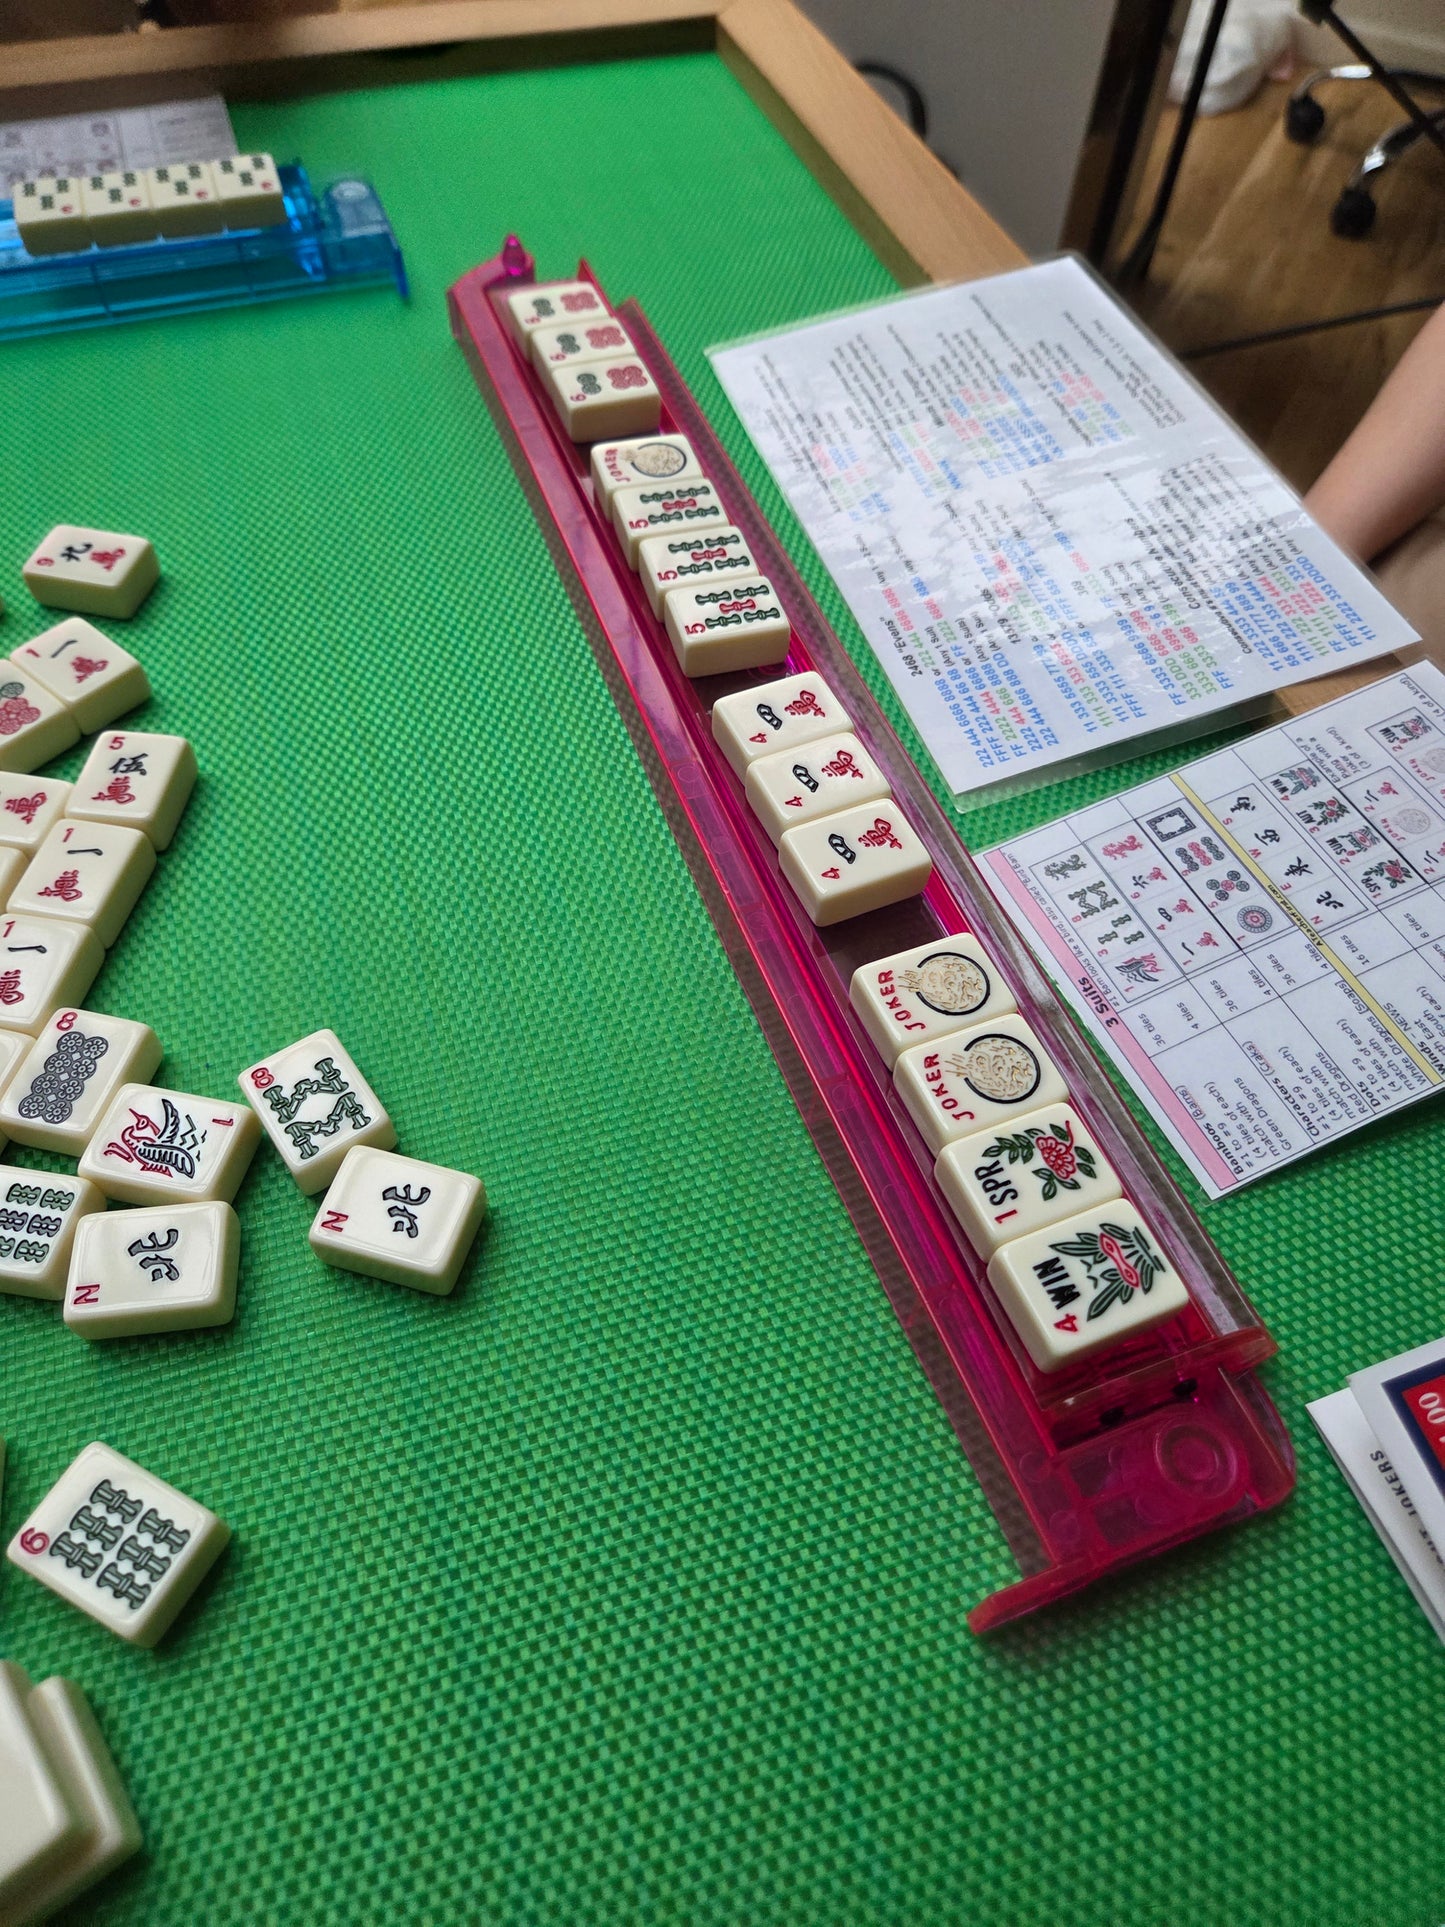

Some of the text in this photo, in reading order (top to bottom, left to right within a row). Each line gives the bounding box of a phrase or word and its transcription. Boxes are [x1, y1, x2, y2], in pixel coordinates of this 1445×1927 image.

[605, 448, 631, 483] JOKER
[629, 519, 649, 529] 5
[658, 570, 678, 581] 5
[1319, 583, 1342, 601] 333
[1334, 600, 1362, 624] 2222
[685, 623, 705, 635] 5
[1248, 611, 1275, 635] 7777
[1131, 641, 1158, 666] 6666
[1267, 634, 1290, 653] 666
[901, 653, 923, 677] 2468
[936, 648, 956, 667] (Any
[1090, 648, 1115, 672] 3333
[945, 667, 962, 681] 88
[979, 662, 1003, 686] 8888
[1001, 668, 1022, 687] 888
[1107, 673, 1127, 690] 111
[1149, 666, 1176, 691] 3333
[953, 681, 970, 694] 66
[994, 686, 1015, 706] 666
[1013, 687, 1034, 706] 666
[1167, 690, 1187, 706] FF
[961, 694, 982, 714] 444
[963, 666, 1027, 757] FF 2222 4444 6666
[1052, 674, 1099, 733] 11 333 5555
[1119, 690, 1147, 718] FFFF
[933, 677, 995, 768] 222 444 6666 8888
[973, 714, 994, 733] 222
[1006, 705, 1027, 726] 444
[1026, 706, 1047, 726] 444
[109, 736, 126, 750] 5
[749, 733, 767, 743] 4
[1018, 726, 1043, 752] 2222
[1038, 726, 1060, 746] 222
[1377, 726, 1401, 743] SUM
[984, 734, 1011, 762] FFFF
[1305, 750, 1343, 783] Example
[1328, 758, 1352, 778] Pung
[1338, 754, 1361, 773] Joker
[1269, 778, 1291, 802] 4 WIN
[785, 796, 802, 807] 4
[1221, 817, 1233, 825] S
[1295, 808, 1320, 833] 3 AUT
[1377, 817, 1407, 843] JOKER
[62, 828, 74, 842] 1
[1324, 836, 1347, 855] SUM
[1248, 847, 1262, 857] W
[821, 867, 840, 879] 4
[1279, 882, 1292, 890] E
[1359, 875, 1381, 893] SPR
[1070, 914, 1082, 922] 8
[1155, 923, 1166, 931] 4
[1310, 915, 1323, 925] N
[1401, 912, 1423, 931] tiles
[3, 920, 16, 938] 1
[1338, 934, 1370, 965] 16 tiles
[878, 969, 926, 1031] JOKER
[1075, 975, 1119, 1028] 3 Suits
[1415, 985, 1443, 1011] each)
[56, 1011, 78, 1031] 8
[1174, 1001, 1194, 1021] tiles
[1136, 1012, 1165, 1047] 36 tiles
[1364, 1015, 1404, 1055] Dragons
[1382, 1001, 1445, 1075] Winds NEWS
[1412, 1018, 1435, 1039] East
[251, 1067, 275, 1089] 8
[1399, 1056, 1428, 1085] White
[924, 1053, 975, 1121] JOKER
[1241, 1039, 1321, 1137] Characters (Craks)
[1313, 1050, 1369, 1114] Red Dragons
[1354, 1080, 1381, 1108] Dots
[1202, 1080, 1267, 1159] (4 tiles of each)
[1232, 1075, 1293, 1151] Green Dragons
[1174, 1083, 1245, 1176] Bamboos (Bams)
[1233, 1100, 1280, 1158] match with
[1228, 1138, 1242, 1151] to
[974, 1159, 1018, 1224] 1 SPR
[321, 1209, 349, 1233] N
[73, 1283, 101, 1305] N
[1033, 1257, 1081, 1333] 4 WIN
[20, 1527, 50, 1555] 6
